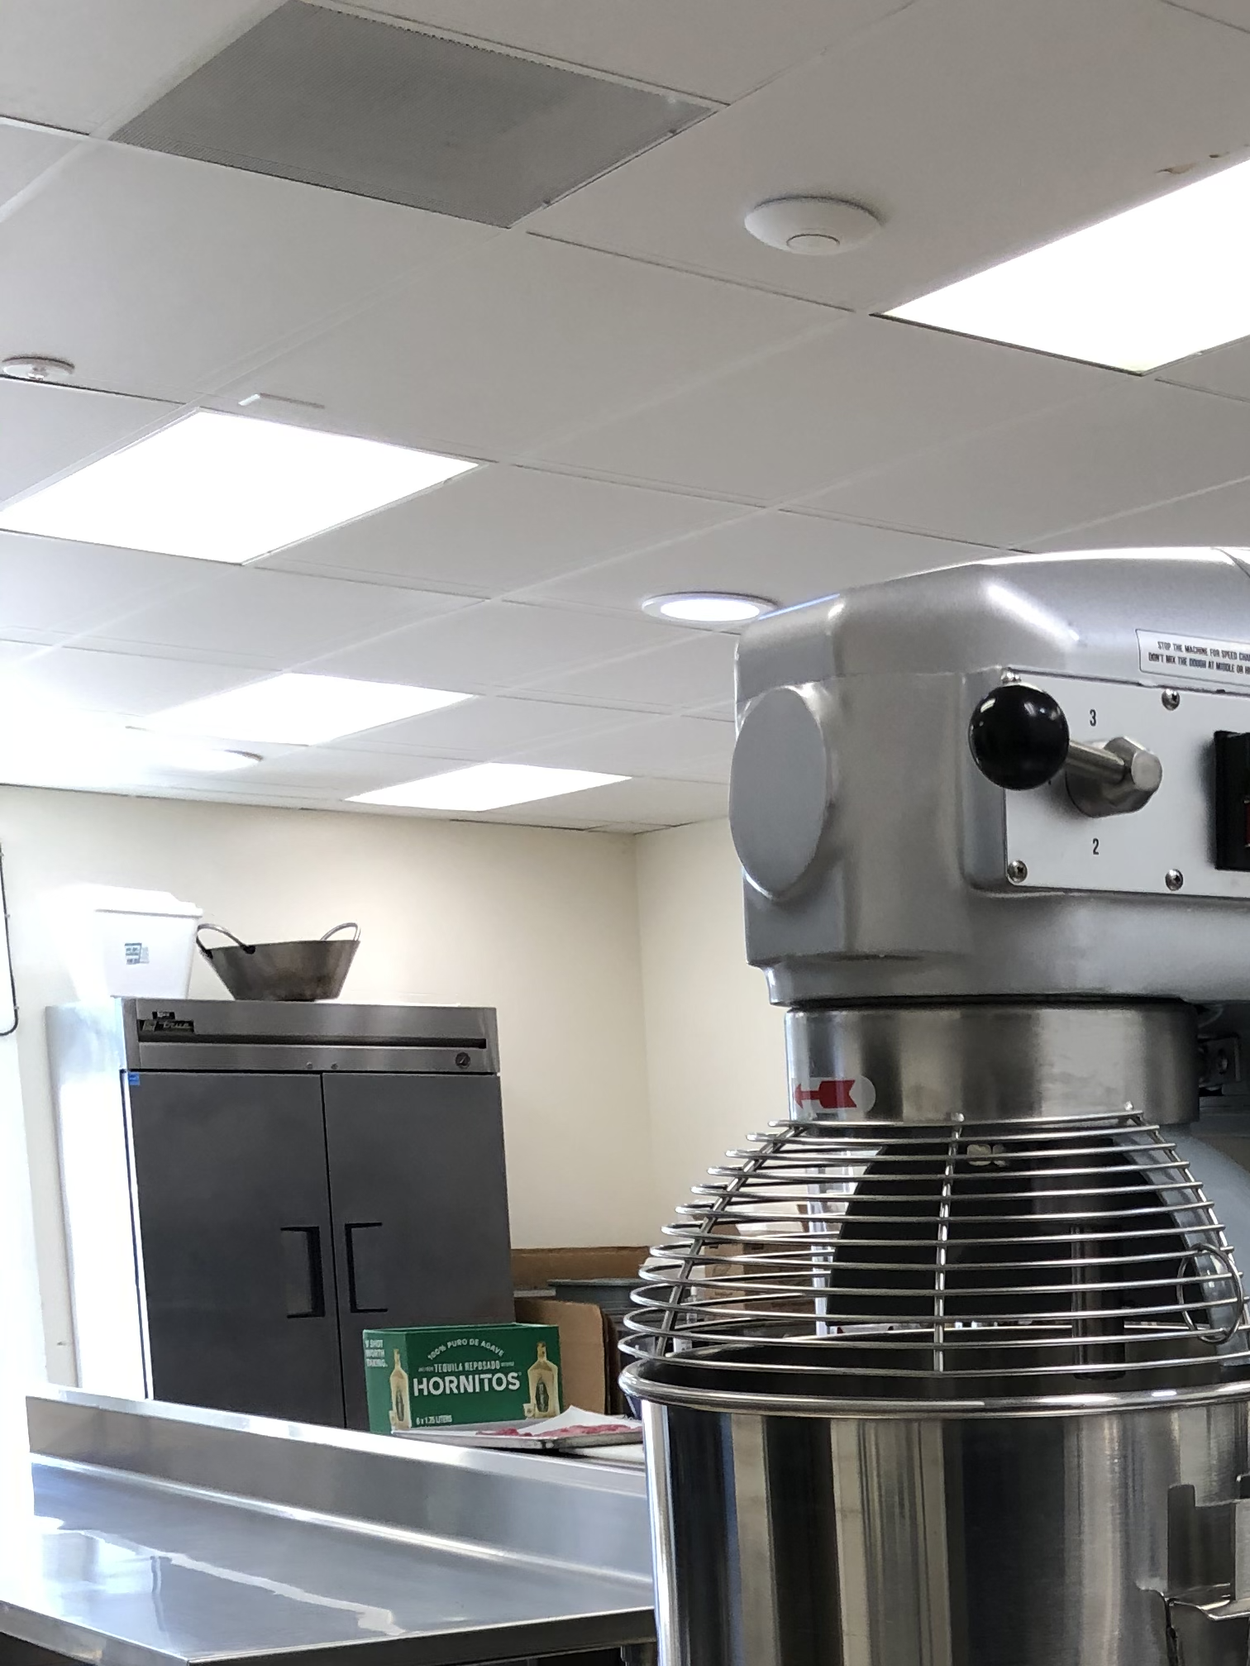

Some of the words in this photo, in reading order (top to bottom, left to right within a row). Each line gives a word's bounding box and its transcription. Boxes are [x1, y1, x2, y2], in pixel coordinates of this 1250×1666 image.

[1157, 641, 1171, 651] STOP
[1173, 643, 1183, 653] THE
[1184, 644, 1208, 656] MACHINE
[1210, 648, 1220, 657] FOR
[1221, 649, 1237, 660] SPEED
[1148, 652, 1164, 663] DON'T
[1178, 656, 1188, 666] THE
[1189, 657, 1206, 668] DOUGH
[1208, 660, 1214, 669] AT
[1216, 661, 1234, 672] MIDDLE
[1236, 664, 1244, 673] OR
[1089, 709, 1097, 727] 3
[1092, 838, 1100, 855] 2
[447, 1338, 467, 1348] PURO
[469, 1338, 479, 1346] DE
[480, 1340, 504, 1357] AGAVE
[434, 1362, 463, 1373] TEQUILA
[464, 1360, 500, 1371] REPOSADO
[413, 1372, 520, 1397] HORNITOS
